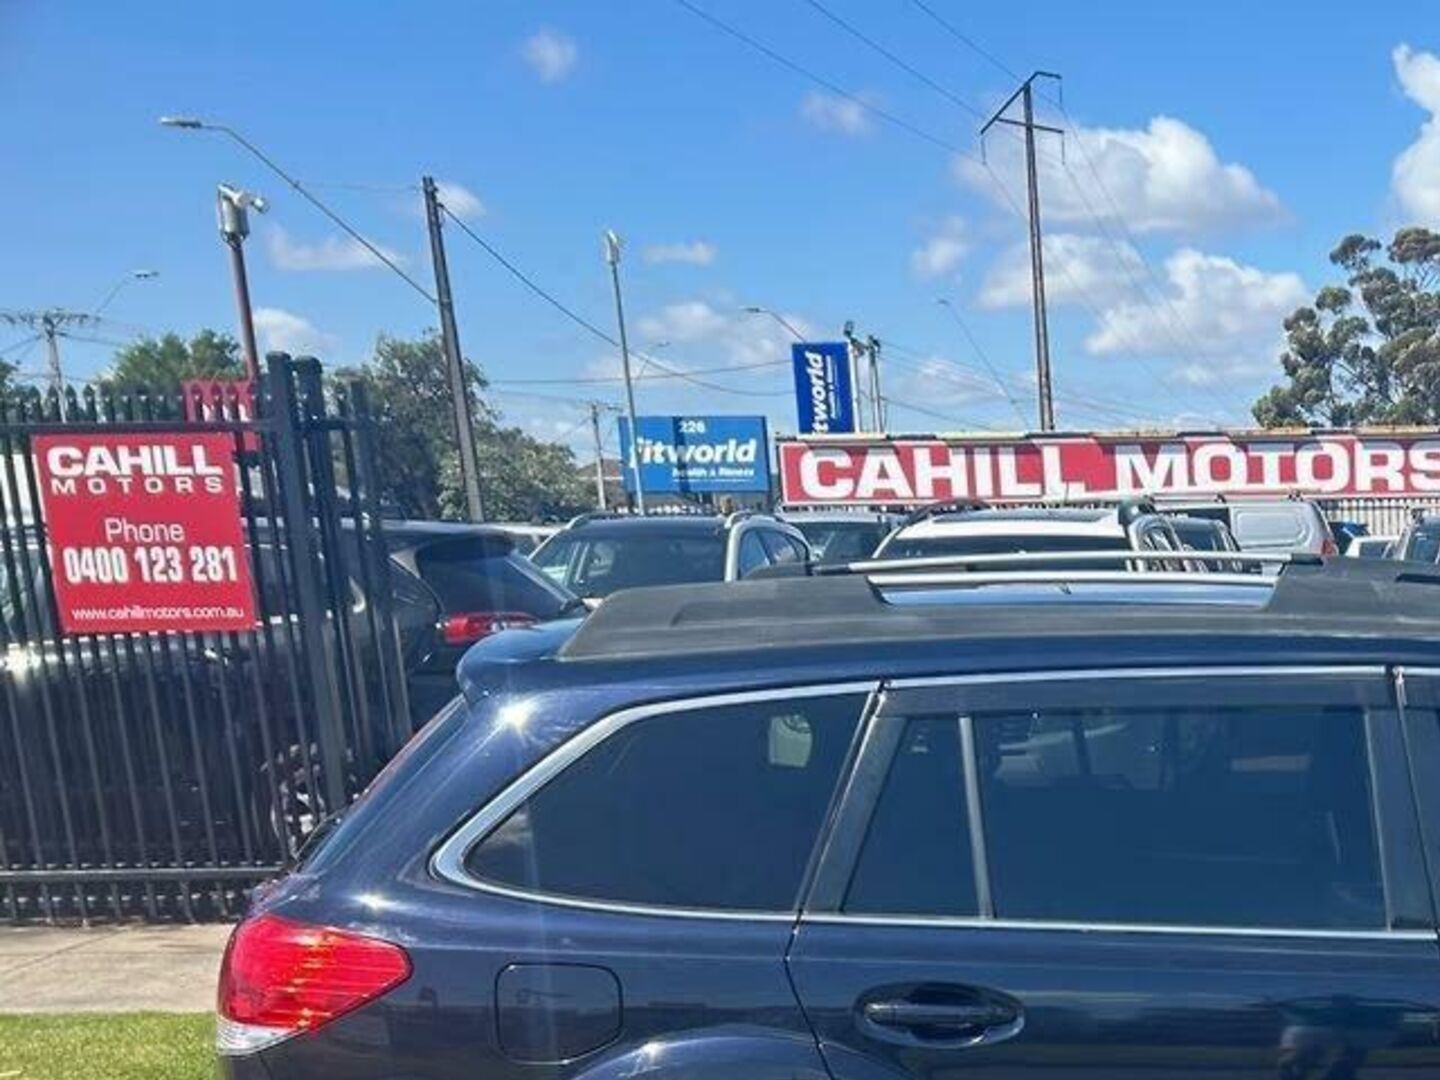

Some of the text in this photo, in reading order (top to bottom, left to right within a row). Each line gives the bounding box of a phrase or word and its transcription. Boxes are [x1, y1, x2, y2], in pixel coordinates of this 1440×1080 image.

[46, 446, 224, 477] CAHILL
[801, 446, 1085, 500] CAHILL
[51, 476, 225, 495] MOTORS
[104, 517, 185, 544] Phone
[62, 546, 238, 583] 0400 123 281
[71, 605, 245, 620] www.cahillmotors.com.au
